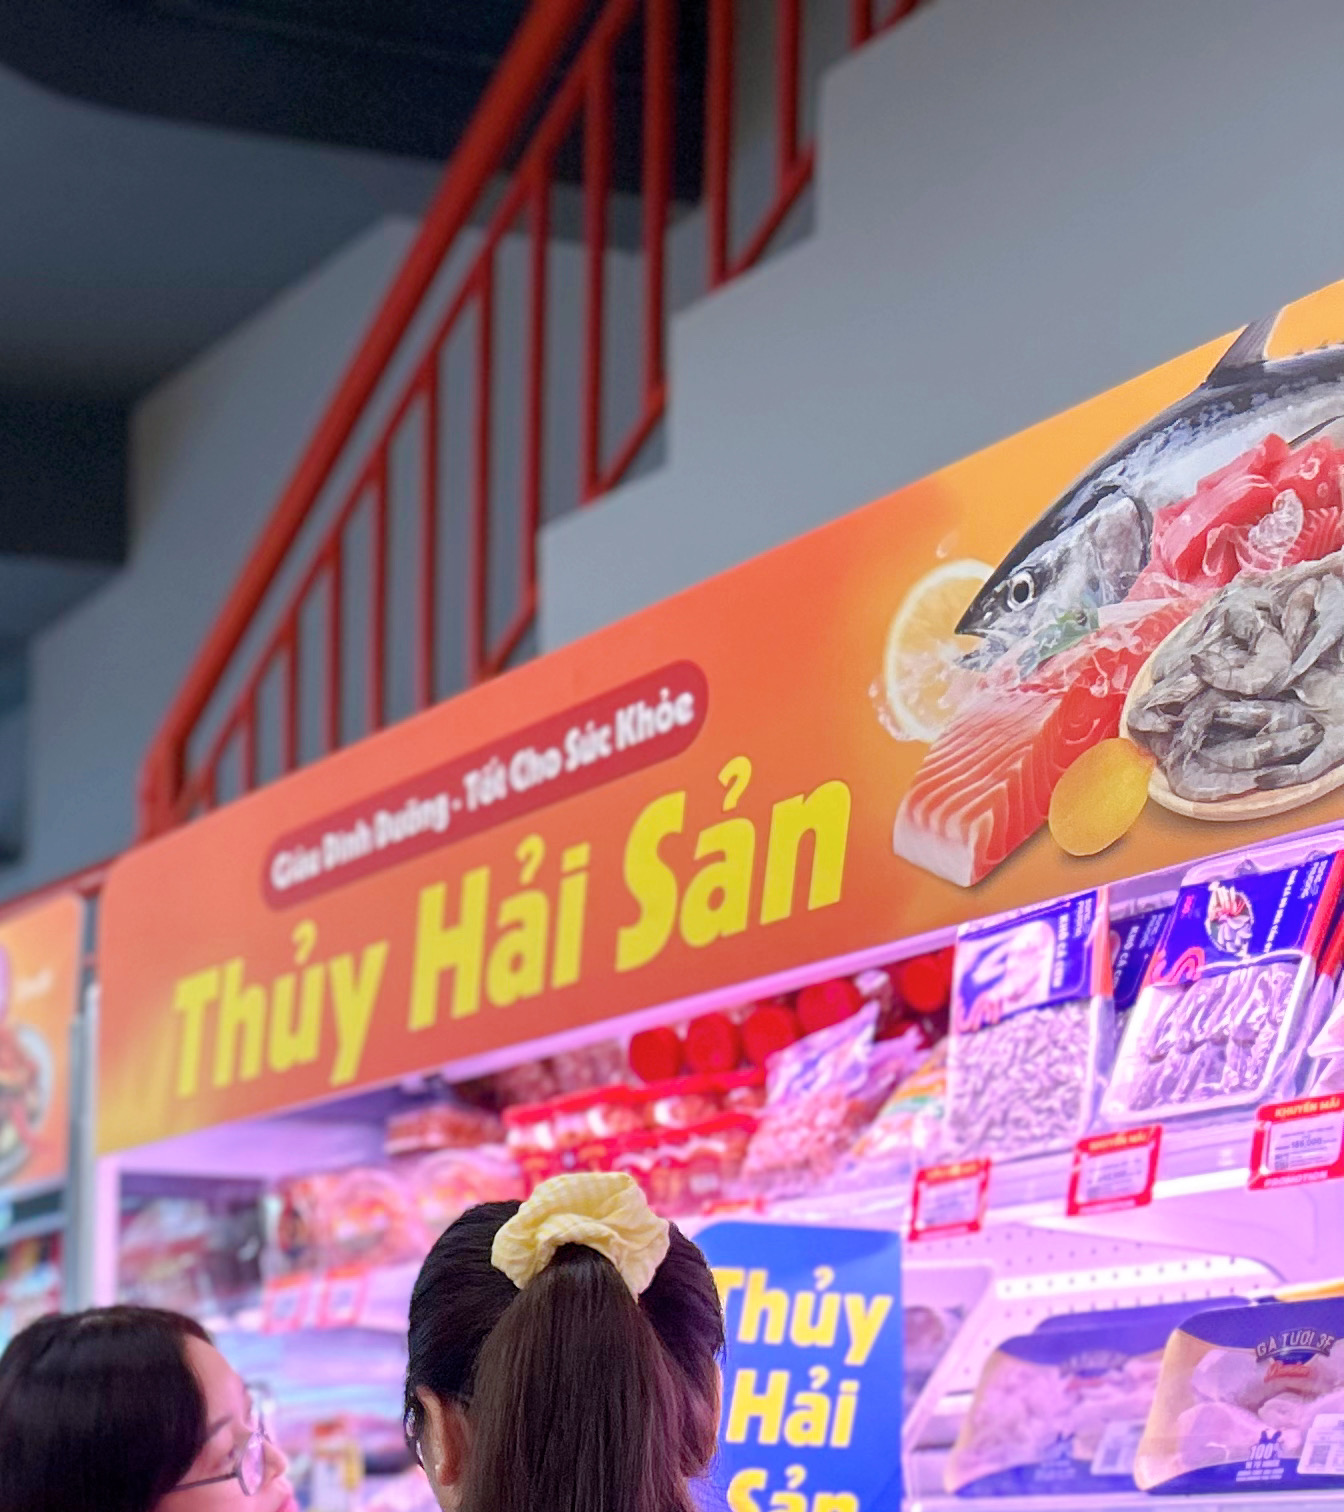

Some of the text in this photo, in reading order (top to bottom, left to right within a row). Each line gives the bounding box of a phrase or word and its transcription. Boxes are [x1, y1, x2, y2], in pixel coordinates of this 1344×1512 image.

[508, 744, 562, 791] Cho
[174, 755, 852, 1098] Thủy Hải Sản
[724, 1367, 860, 1448] Hải
